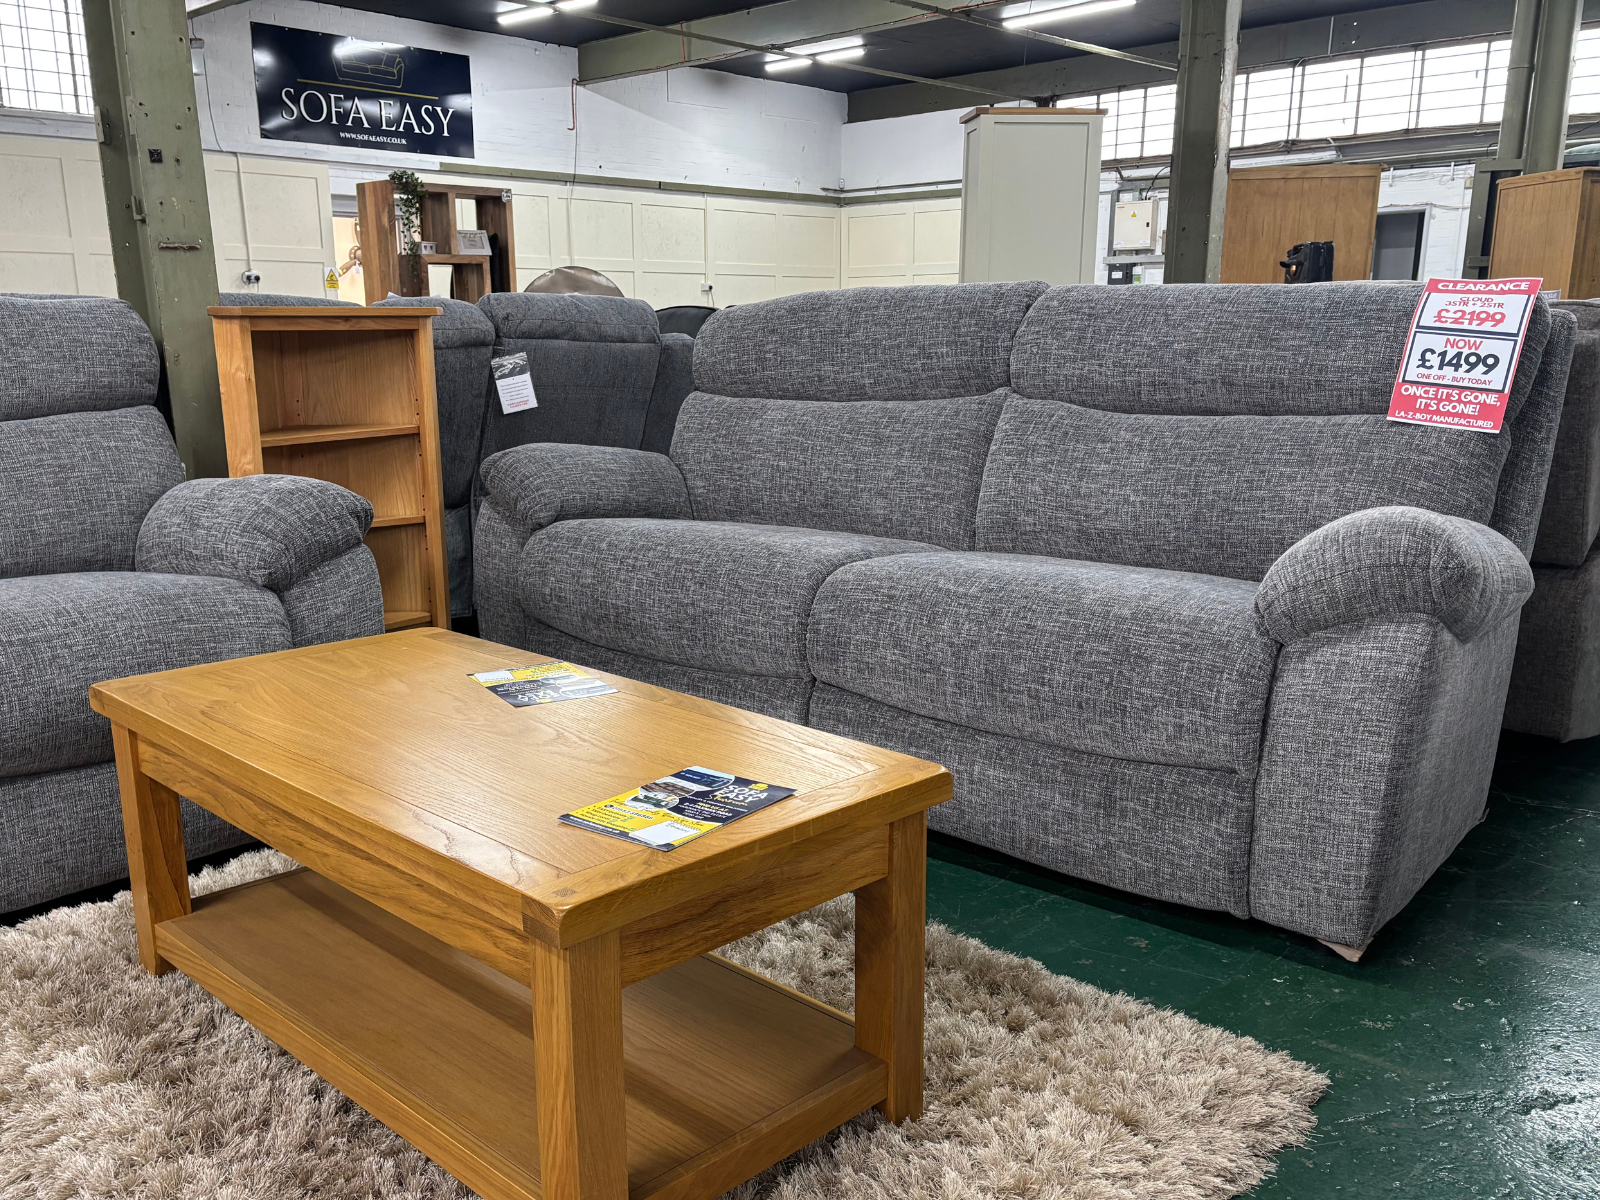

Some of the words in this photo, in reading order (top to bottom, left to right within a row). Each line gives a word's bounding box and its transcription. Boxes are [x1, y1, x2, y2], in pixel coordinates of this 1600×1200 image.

[281, 87, 371, 129] SOFA
[378, 98, 456, 137] EASY
[339, 131, 407, 145] WWW.SOFAEASY.CO.UK
[1437, 281, 1531, 291] CLEARANCE
[1478, 301, 1505, 309] 2STR
[1433, 308, 1506, 327] £2199
[1444, 337, 1483, 351] NOW
[1416, 348, 1500, 375] £1499
[1416, 372, 1434, 380] ONE
[1434, 374, 1447, 382] OFF
[1451, 376, 1466, 384] BUY
[1467, 377, 1494, 386] TODAY
[1401, 384, 1436, 398] ONCE
[1437, 388, 1459, 401] IT'S
[1461, 391, 1501, 407] GONE,
[1416, 398, 1438, 411] IT'S
[1439, 401, 1480, 415] GONE!
[1395, 410, 1431, 421] LA-Z-BOY
[1432, 415, 1494, 428] MANUFACTURED
[713, 789, 760, 803] EASY
[724, 785, 769, 799] SOFA
